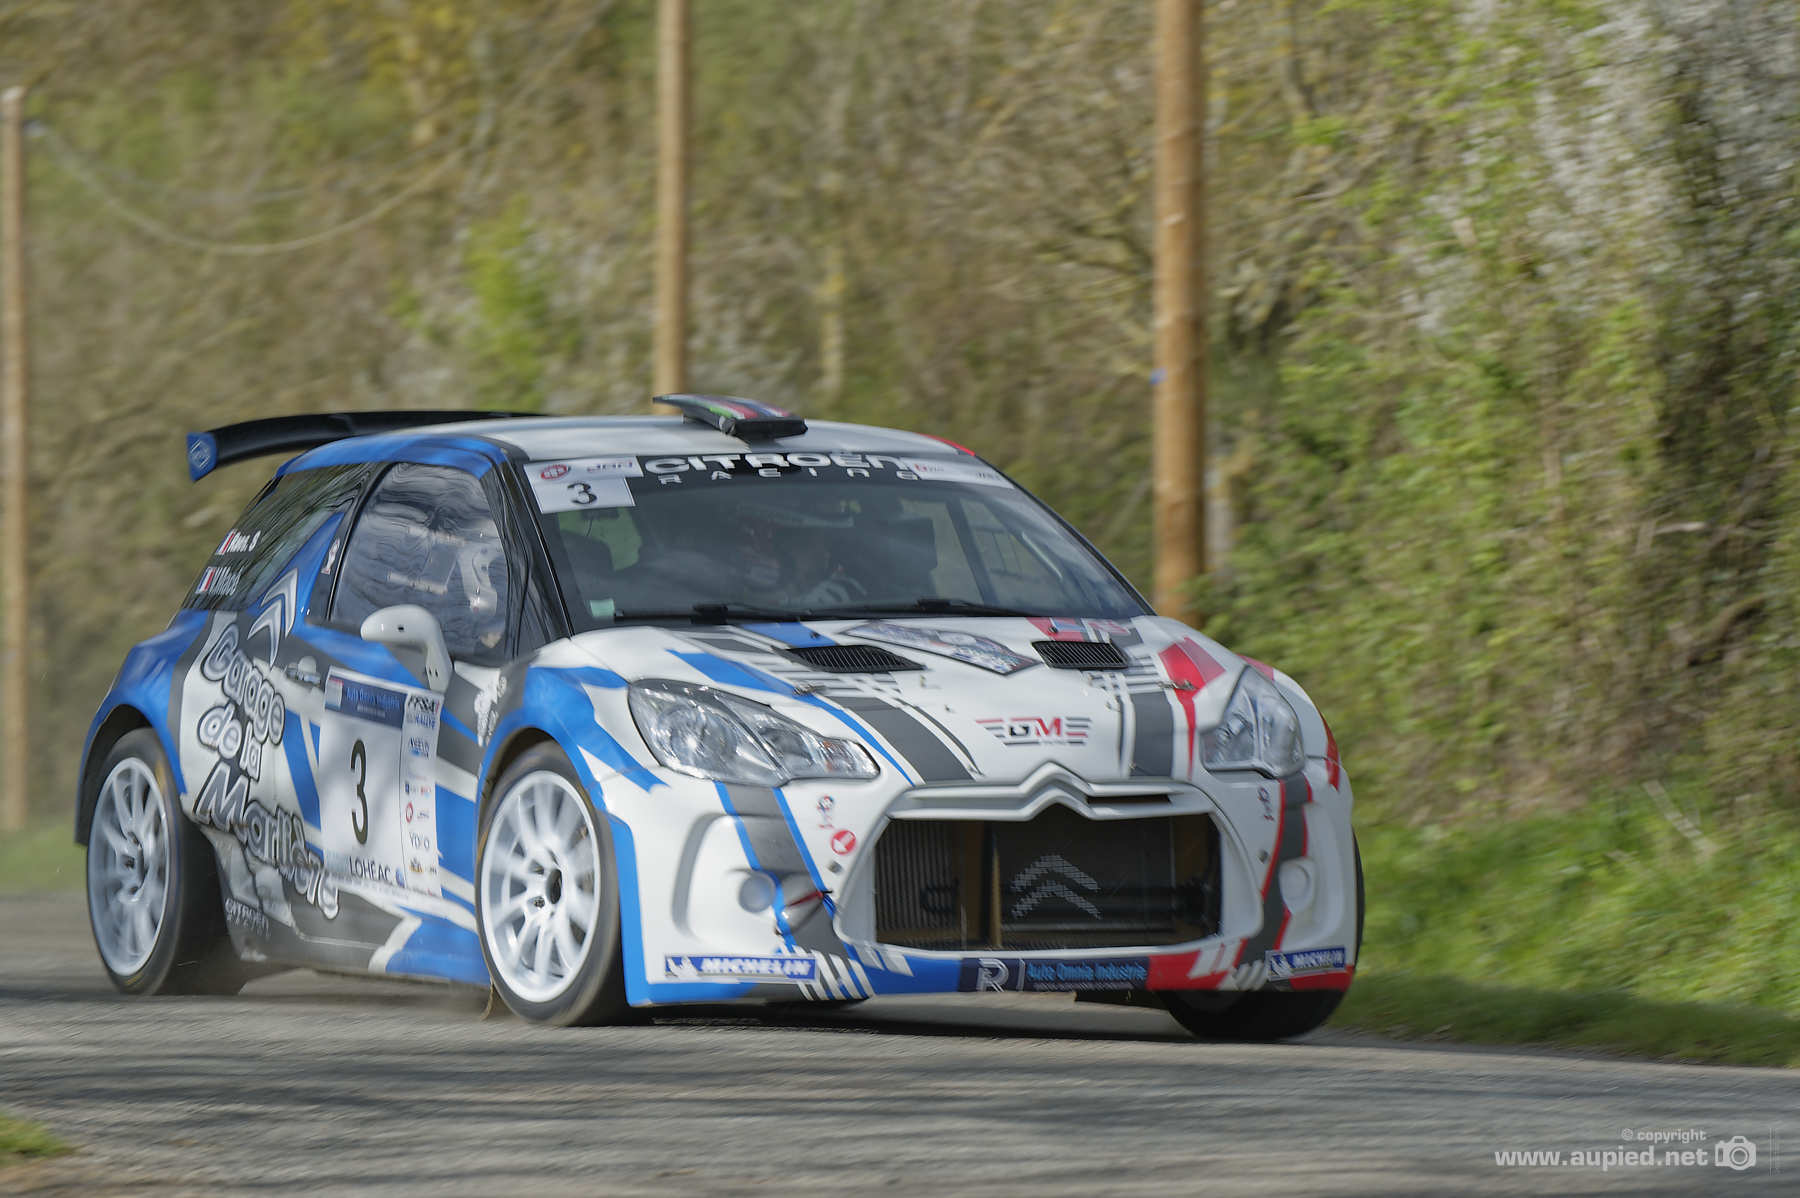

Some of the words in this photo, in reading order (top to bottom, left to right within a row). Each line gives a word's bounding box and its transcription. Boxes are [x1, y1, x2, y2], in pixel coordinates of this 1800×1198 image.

[658, 467, 918, 485] RACING
[567, 482, 598, 505] 3
[201, 623, 285, 746] Garage
[198, 701, 242, 759] de
[240, 720, 262, 781] la
[350, 739, 369, 845] 3
[700, 957, 812, 976] MICHELIN
[1291, 949, 1344, 969] MICHELIN
